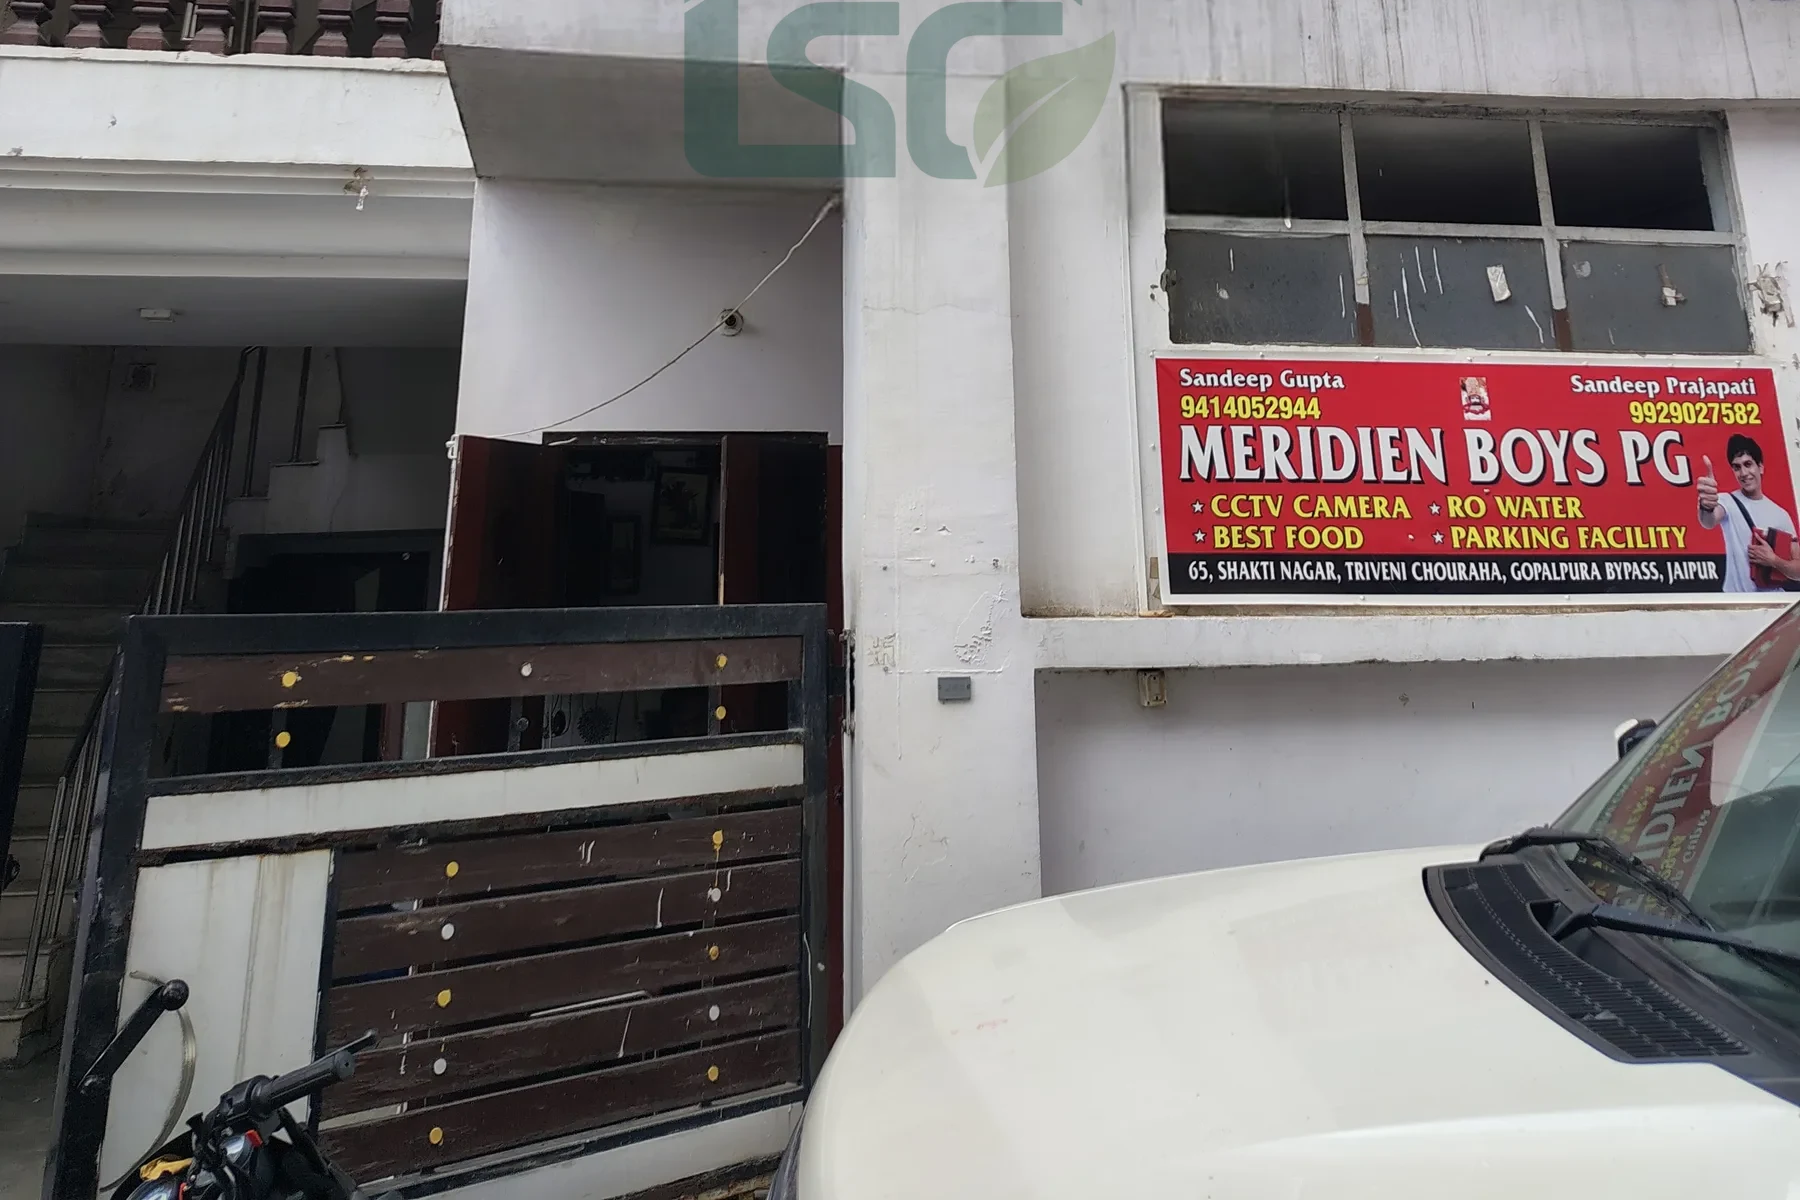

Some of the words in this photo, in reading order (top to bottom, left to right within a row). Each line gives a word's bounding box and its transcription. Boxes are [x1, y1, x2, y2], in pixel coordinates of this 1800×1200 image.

[1179, 368, 1273, 392] Sandeep
[1279, 369, 1345, 393] Gupta
[1570, 374, 1660, 398] Sandeep
[1666, 376, 1756, 399] Prajapati
[1180, 395, 1321, 420] 9414052944
[1629, 401, 1762, 425] 9929027582
[1179, 424, 1449, 485] MERIDIEN
[1462, 428, 1607, 486] BOYS
[1618, 430, 1693, 486] PG
[1210, 494, 1284, 518] CCTV
[1293, 495, 1413, 519] CAMERA
[1447, 495, 1487, 519] RO
[1495, 496, 1585, 519] WATER
[1213, 526, 1275, 549] BEST
[1285, 526, 1364, 549] FOOD
[1451, 526, 1569, 550] PARKING
[1576, 526, 1687, 549] FACILITY
[1188, 561, 1213, 583] 65,
[1217, 561, 1275, 581] SHAKTI
[1280, 561, 1341, 583] NAGAR,
[1345, 561, 1407, 582] TRIVENI
[1411, 561, 1507, 584] CHOURAHA,
[1510, 561, 1602, 582] GOPALPURA
[1606, 562, 1664, 583] BYPASS,
[1667, 561, 1719, 585] JAIPUR
